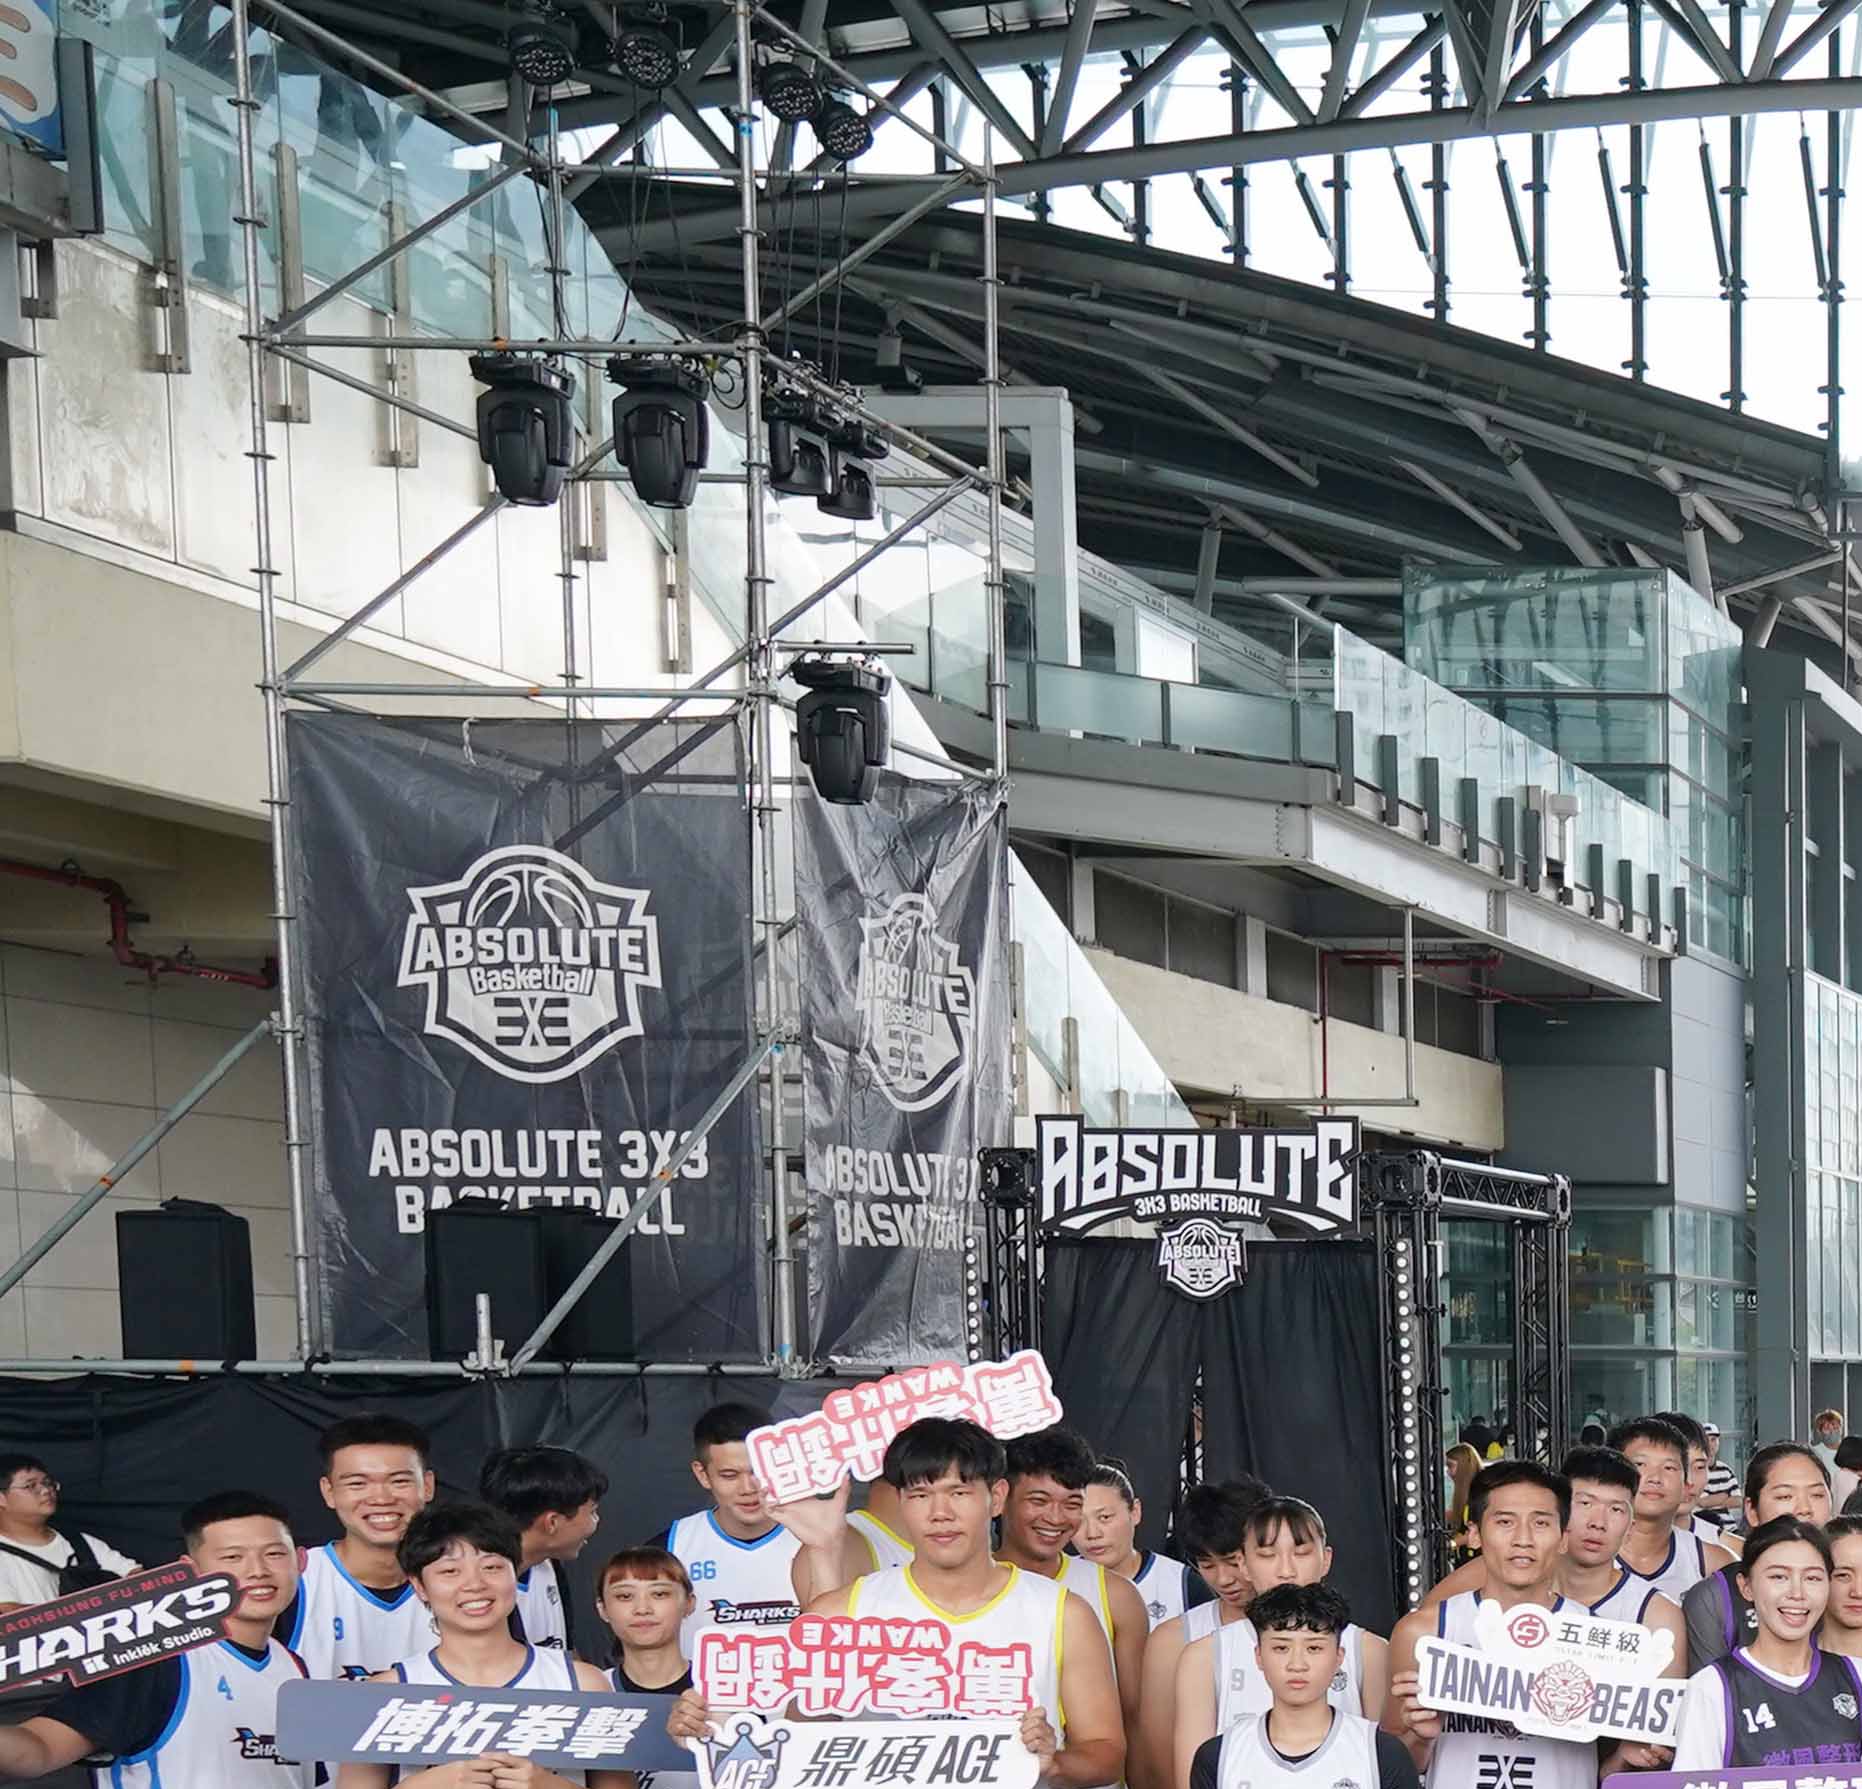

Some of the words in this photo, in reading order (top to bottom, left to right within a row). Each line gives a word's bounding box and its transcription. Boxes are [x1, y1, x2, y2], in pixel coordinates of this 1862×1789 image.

[413, 926, 645, 973] ABSOLUTE
[470, 963, 595, 996] Basketball
[368, 1128, 603, 1179] ABSOLUTE
[619, 1130, 710, 1180] 3X3
[1041, 1117, 1358, 1222] ABSOLUTE
[1164, 1244, 1237, 1262] ABSOLUTE
[688, 1560, 717, 1581] 66
[0, 1578, 232, 1678] HARKS
[1556, 1621, 1642, 1655] 五鮮級
[216, 1674, 233, 1701] 4
[700, 1628, 1034, 1718] 萬客什鍋
[1425, 1646, 1537, 1714] TAINAN
[351, 1697, 650, 1759] 博拓拳擊
[1742, 1702, 1777, 1734] 14
